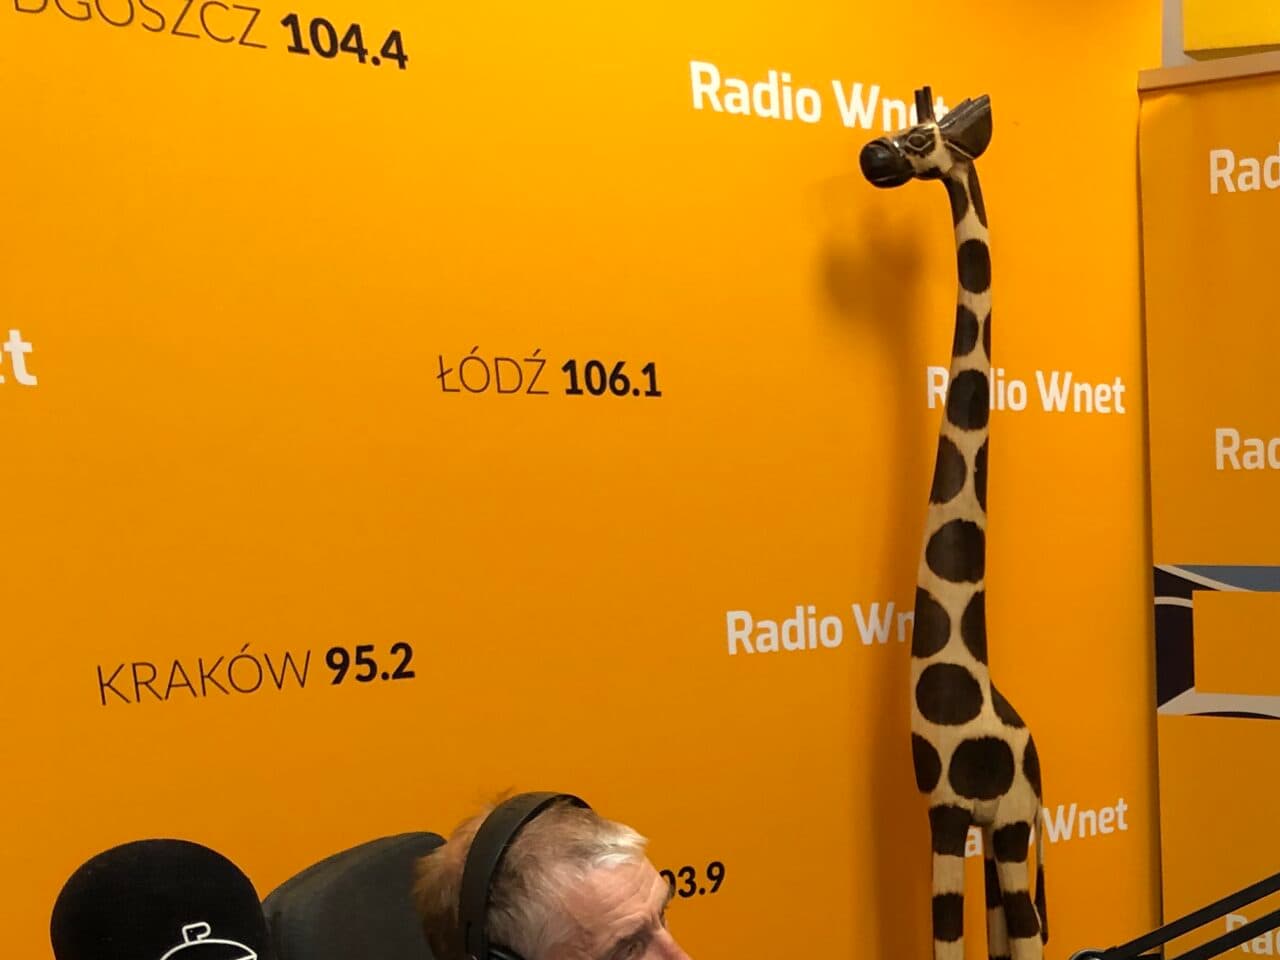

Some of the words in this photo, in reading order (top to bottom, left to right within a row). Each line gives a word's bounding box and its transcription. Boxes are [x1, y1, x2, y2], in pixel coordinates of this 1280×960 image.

[13, 0, 268, 49] GOSZCZ
[280, 12, 409, 70] 104.4
[690, 60, 822, 124] Radio
[436, 345, 549, 396] ŁÓDŹ
[561, 358, 663, 398] 106.1
[927, 366, 1027, 411] Rio
[1035, 369, 1126, 414] Wnet
[726, 604, 844, 656] Radio
[852, 601, 915, 646] Wn
[97, 642, 312, 706] KRAKÓW
[325, 641, 416, 686] 95.2
[1042, 797, 1128, 843] Wnet
[658, 860, 726, 899] 03.9
